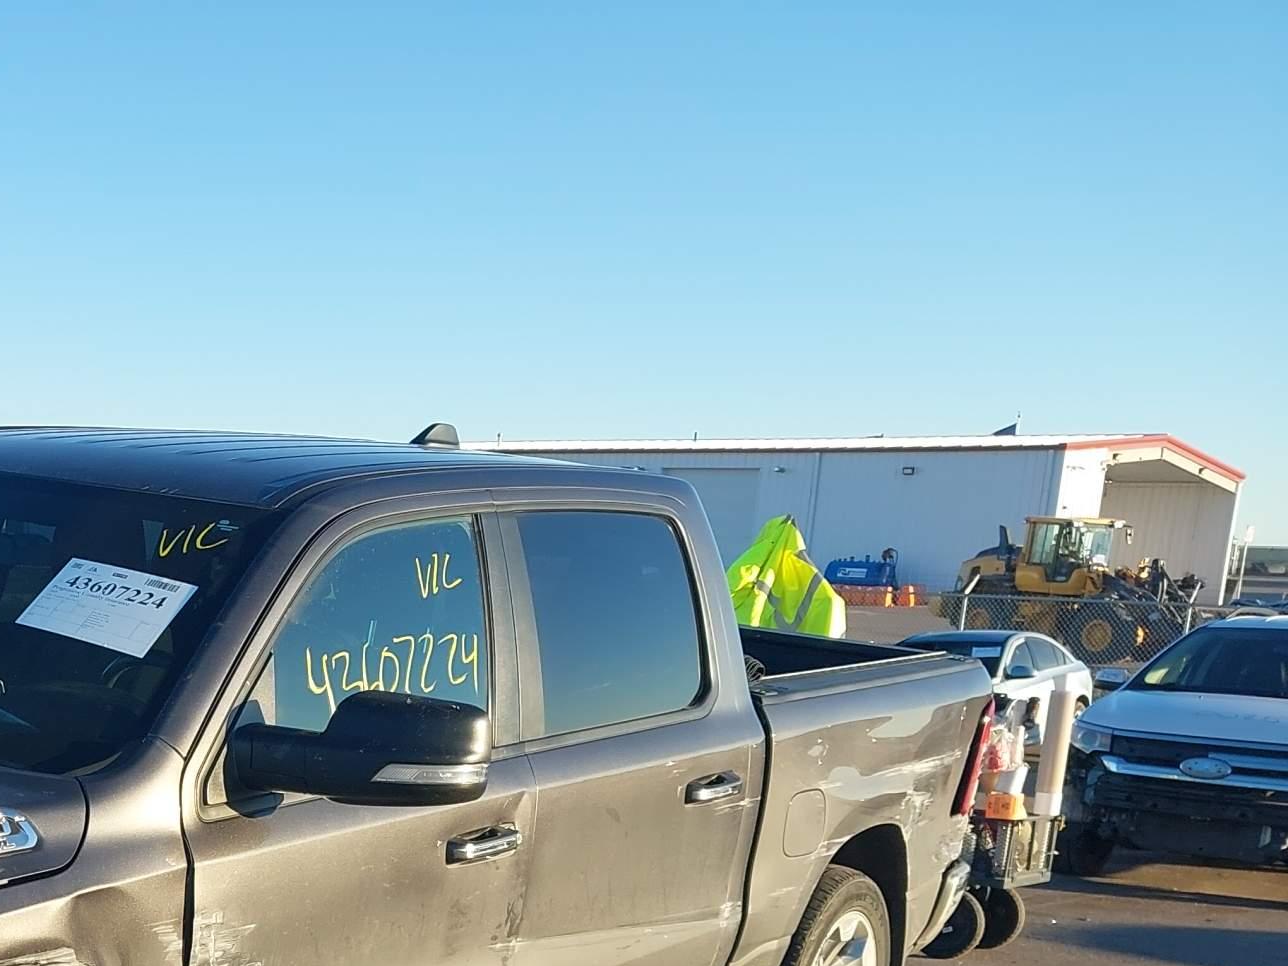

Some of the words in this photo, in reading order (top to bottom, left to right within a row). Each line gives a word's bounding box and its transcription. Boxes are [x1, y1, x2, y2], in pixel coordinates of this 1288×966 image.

[159, 522, 229, 557] VIC
[65, 575, 169, 609] 43607224
[415, 553, 462, 599] VIC
